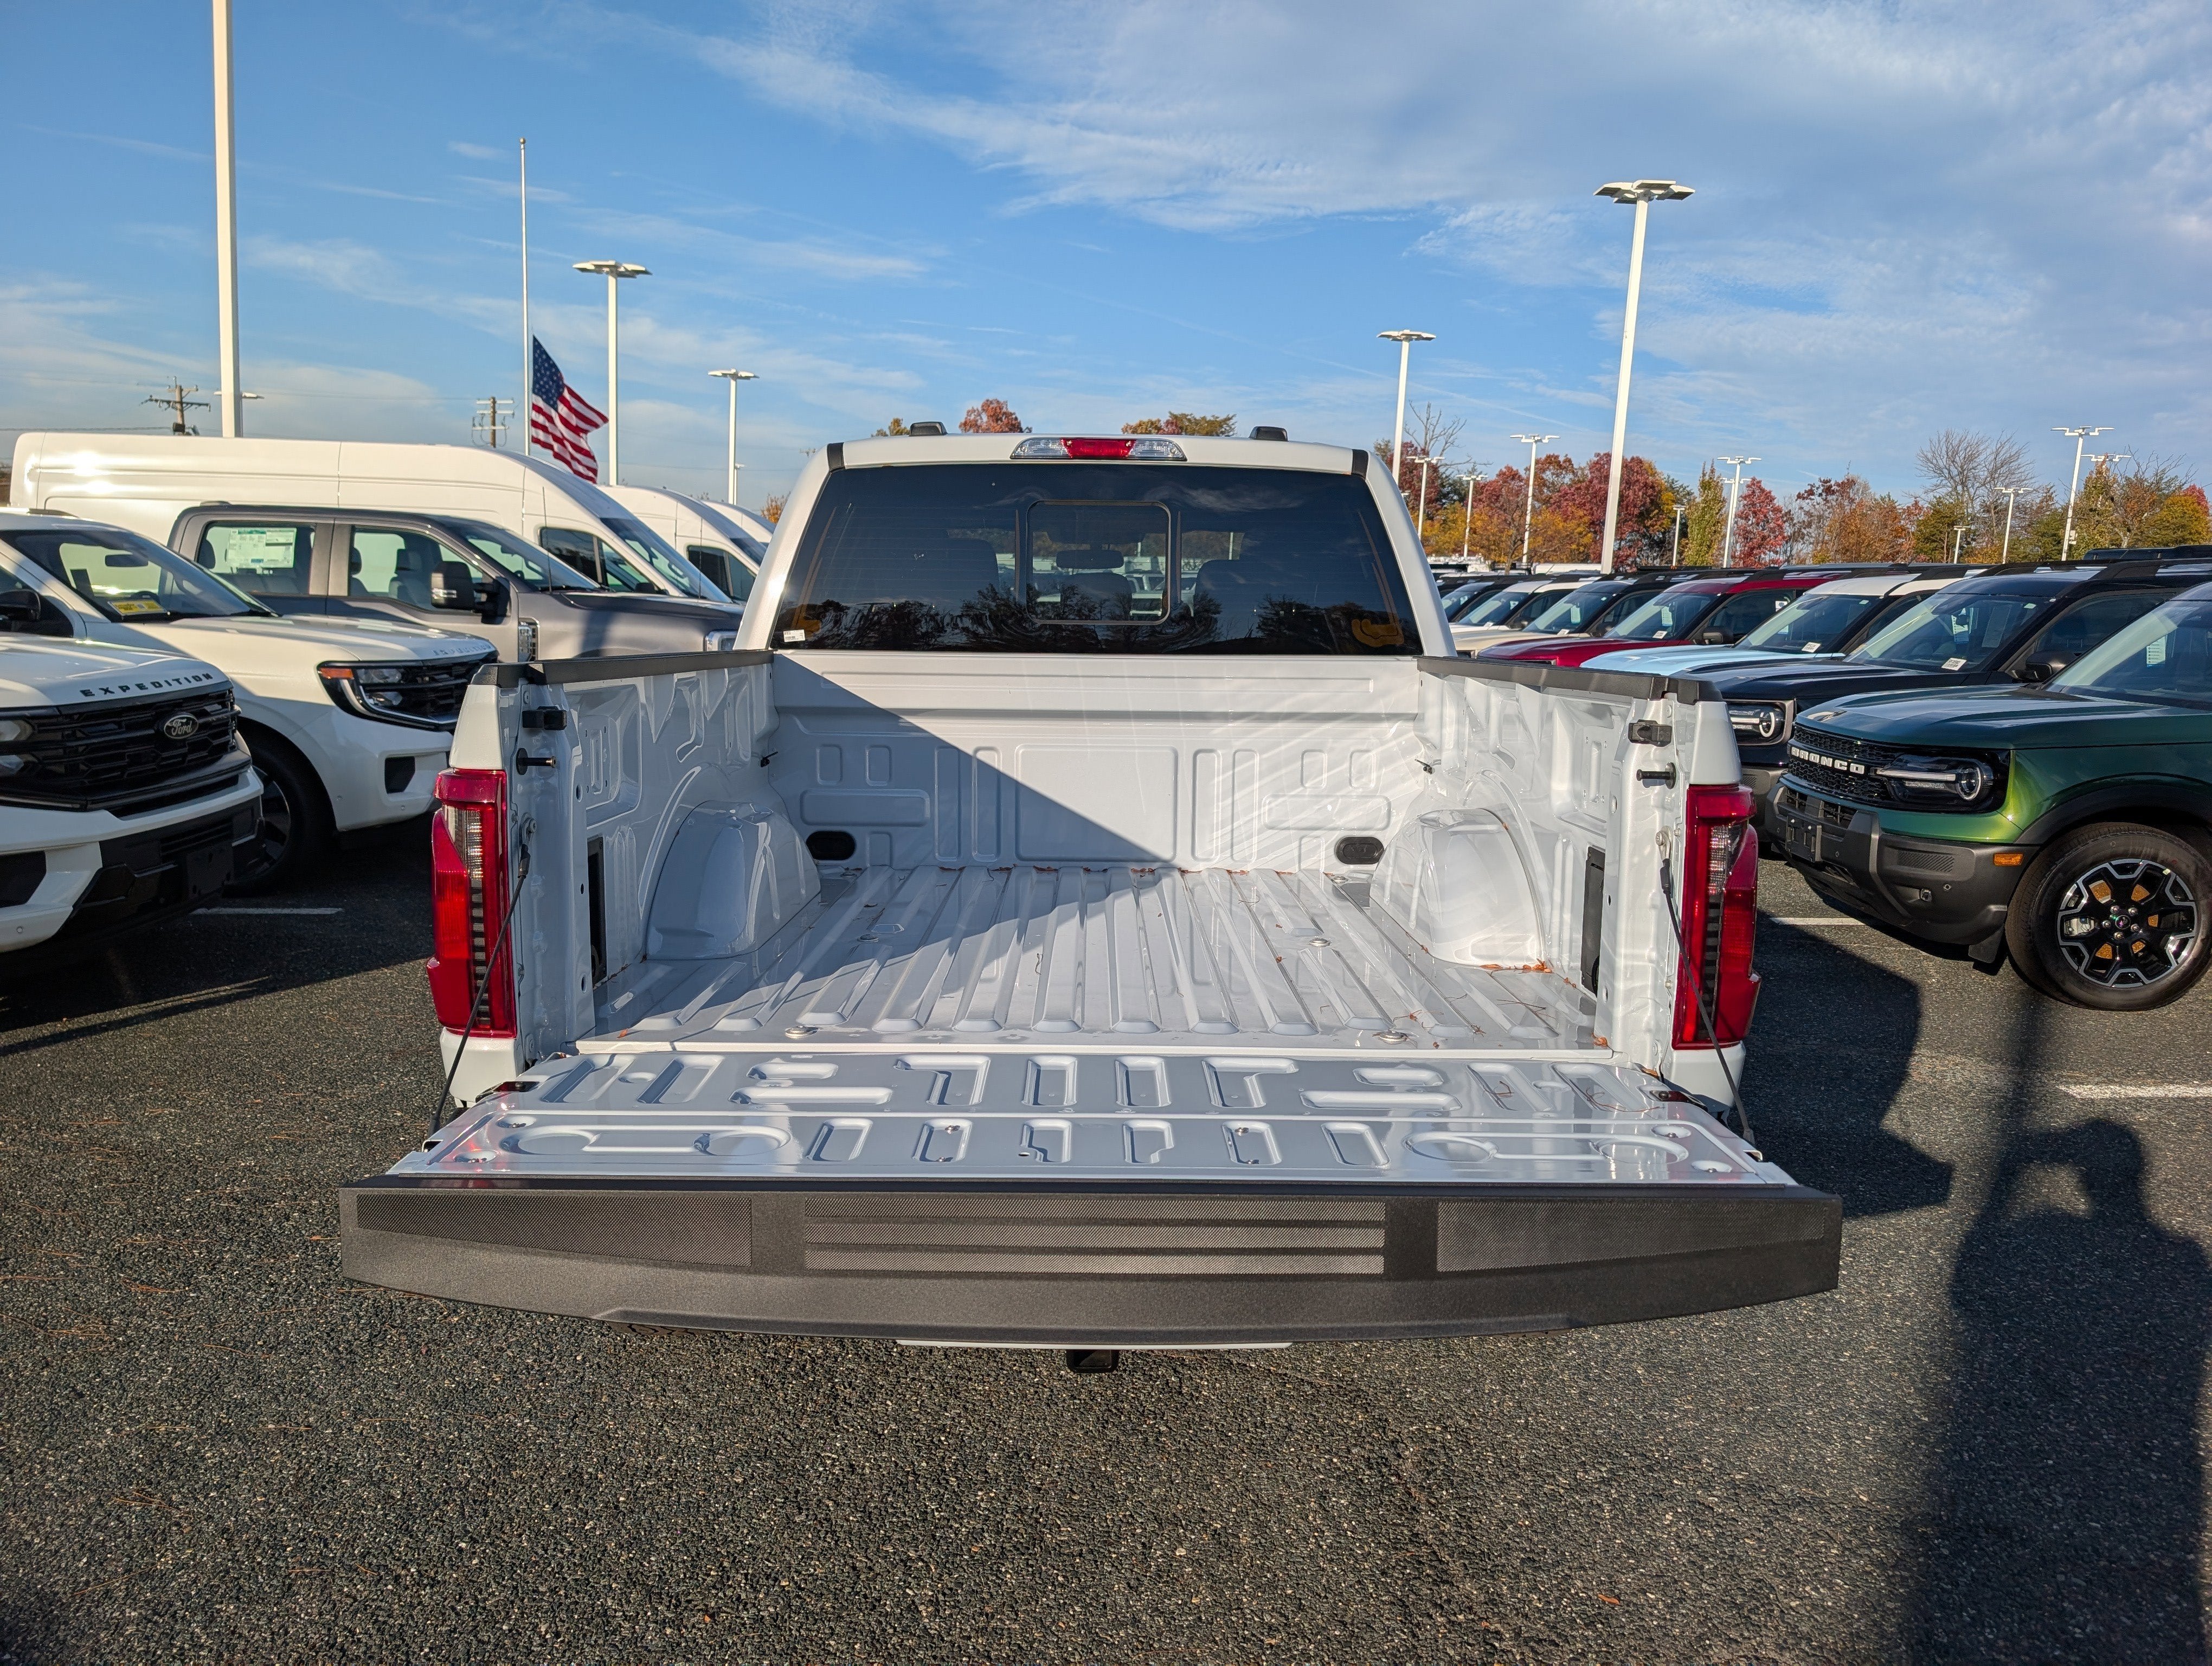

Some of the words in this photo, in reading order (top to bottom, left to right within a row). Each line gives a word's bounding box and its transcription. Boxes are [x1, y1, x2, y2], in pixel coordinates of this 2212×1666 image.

[80, 672, 213, 697] EXPEDITION
[167, 718, 193, 736] Ford
[1791, 746, 1865, 774] BRONCO
